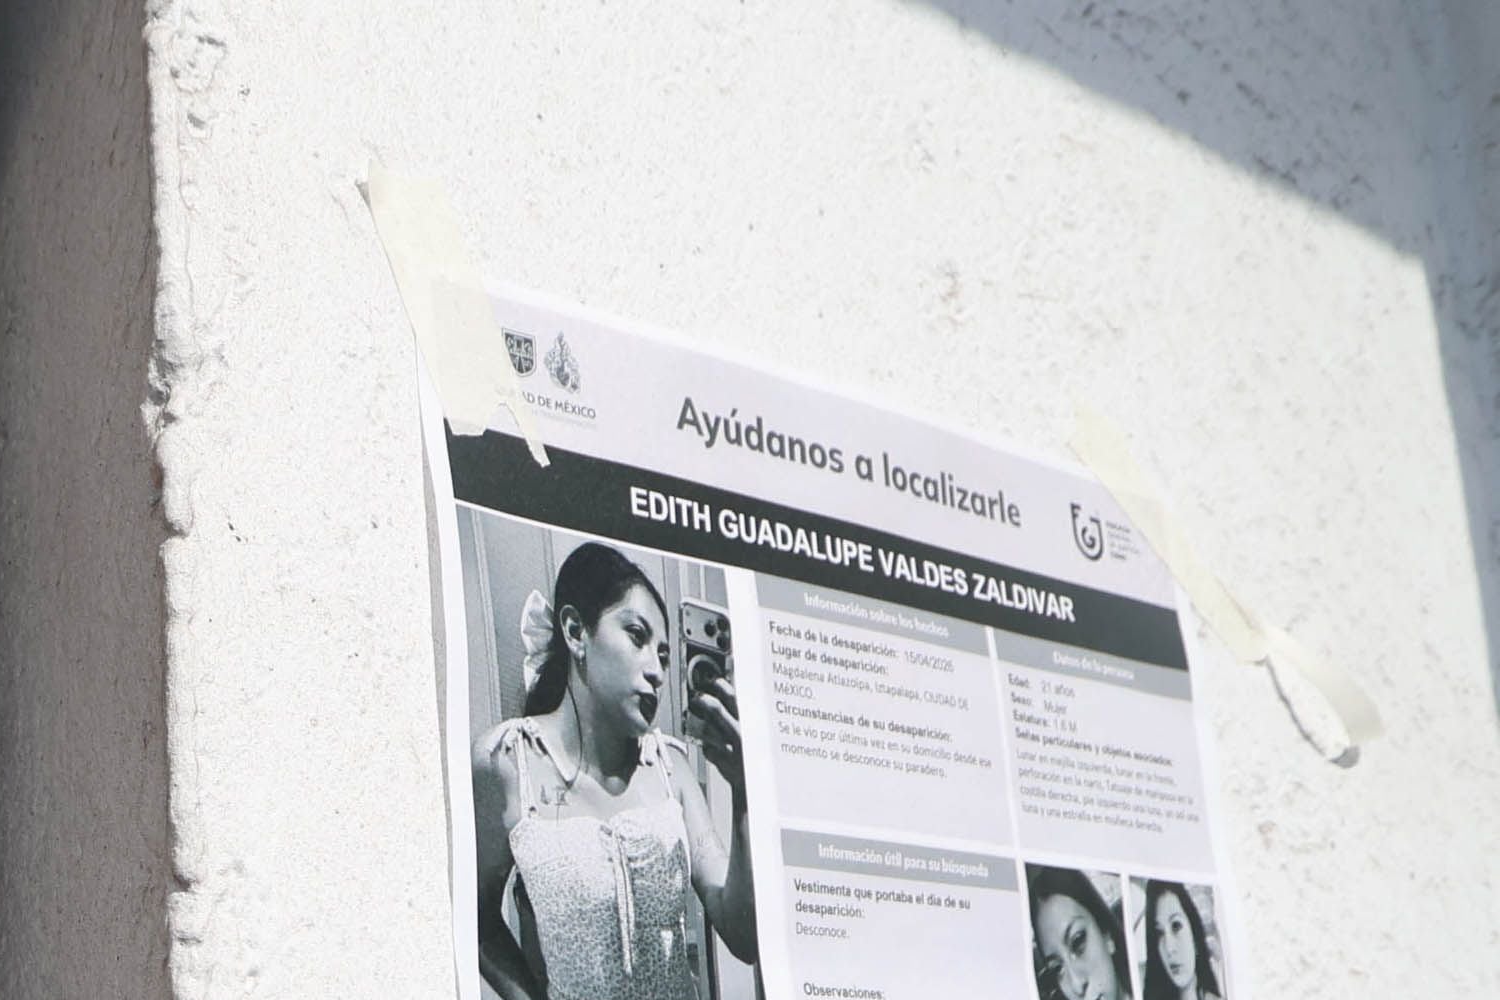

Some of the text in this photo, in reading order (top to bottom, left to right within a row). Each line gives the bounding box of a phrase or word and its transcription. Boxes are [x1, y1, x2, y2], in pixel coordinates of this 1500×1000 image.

[538, 395, 551, 408] DE
[555, 398, 596, 419] MÉXICO
[676, 396, 1022, 527] Ayúdanos a localizarle
[629, 486, 1076, 622] EDITH GUADALUPE VALDES ZALDIVAR
[804, 592, 868, 618] Información
[769, 621, 802, 639] Fecha
[805, 628, 817, 642] de
[820, 632, 829, 644] la
[831, 633, 897, 657] desaparición:
[771, 642, 889, 676] Lugar de desaparición:
[772, 662, 824, 683] Magdalena
[776, 700, 953, 744] Circunstancias de su desaparición:
[778, 721, 790, 734] Se
[792, 723, 801, 736] le
[820, 729, 836, 742] por
[839, 730, 867, 747] última
[781, 743, 828, 760] momento
[830, 750, 840, 761] se
[842, 750, 891, 770] desconoce
[818, 843, 989, 878] Información útil para su búsqueda
[794, 879, 851, 898] Vestimenta
[854, 888, 872, 901] que
[875, 889, 913, 905] portaba
[916, 893, 924, 905] el
[944, 897, 956, 909] de
[959, 900, 971, 910] su
[795, 900, 865, 920] desaparición:
[796, 922, 850, 939] Desconoce.
[803, 982, 886, 1000] Observaciones:
